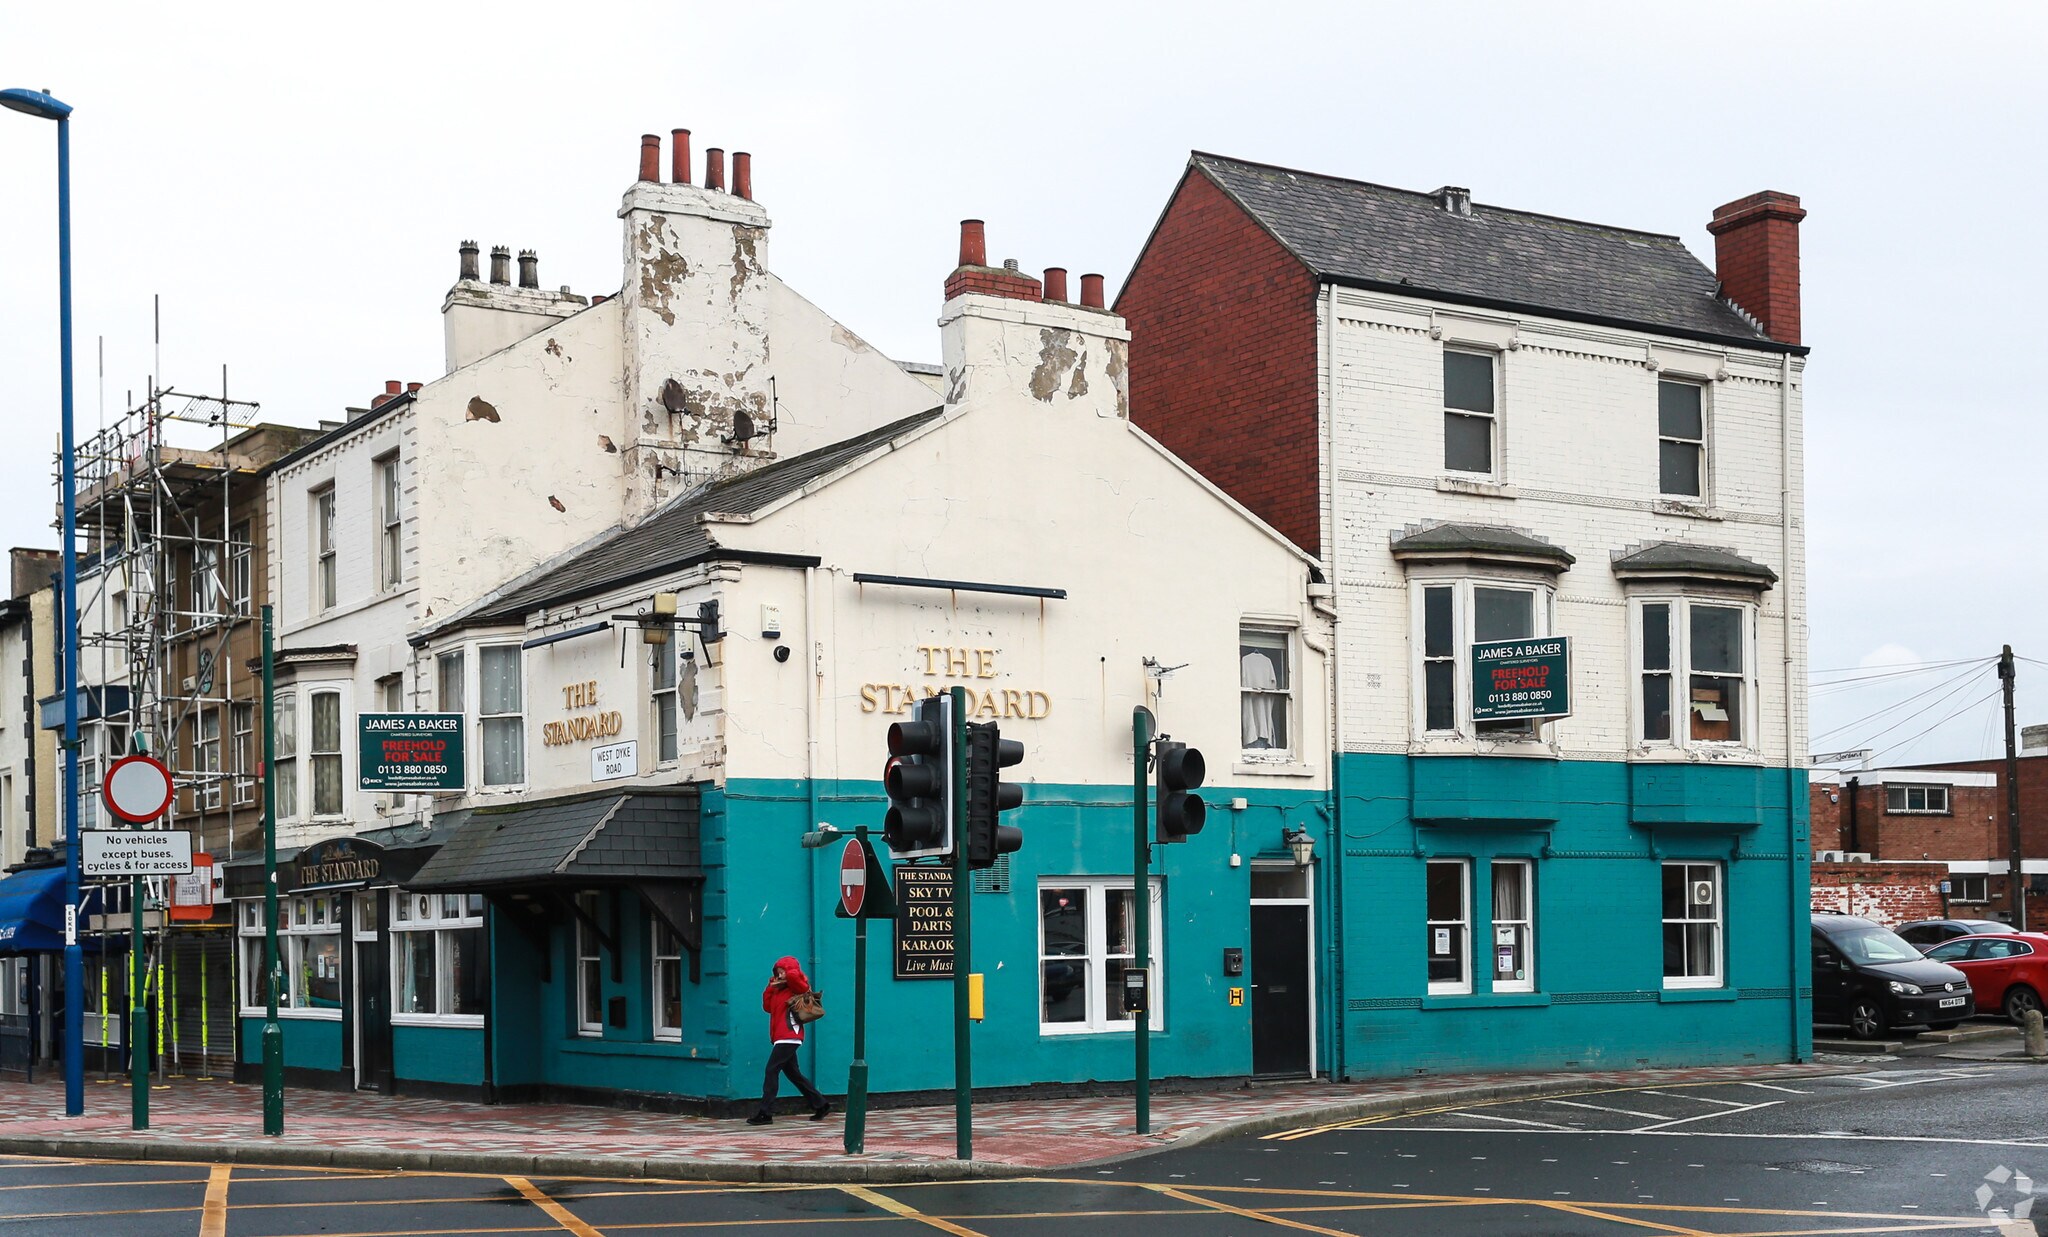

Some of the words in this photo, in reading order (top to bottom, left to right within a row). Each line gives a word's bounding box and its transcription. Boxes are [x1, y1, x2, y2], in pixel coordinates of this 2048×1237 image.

[1477, 647, 1513, 660] JAMES
[1515, 647, 1524, 657] A
[1526, 643, 1561, 656] BAKER
[917, 645, 996, 679] THE
[1491, 665, 1550, 680] FREEHOLD
[1495, 680, 1517, 691] FOR
[1520, 677, 1547, 689] SALE
[562, 680, 598, 710] THE
[1489, 693, 1510, 703] 0113
[1512, 692, 1529, 701] 880
[1530, 690, 1552, 700] 0850
[366, 720, 405, 730] JAMES
[407, 720, 417, 730] A
[419, 720, 458, 730] BAKER
[543, 711, 623, 747] STANDARD
[382, 740, 447, 751] FREEHOLD
[385, 752, 410, 763] FOR
[413, 752, 443, 763] SALE
[597, 750, 613, 763] WEST
[616, 747, 631, 759] DYKE
[378, 765, 402, 774] 0113
[404, 765, 422, 774] 880
[424, 765, 448, 774] 0850
[606, 763, 622, 775] ROAD
[106, 836, 122, 845] No
[125, 836, 168, 845] vehicles
[102, 850, 138, 860] except
[87, 862, 121, 872] cycles
[125, 861, 132, 870] &
[135, 861, 151, 870] for
[301, 865, 320, 884] THE
[322, 859, 379, 883] STANDARD
[899, 872, 917, 880] THE
[918, 872, 953, 881] STANDA
[909, 888, 934, 898] SKY
[936, 888, 953, 898] TV
[909, 907, 943, 918] POOL
[945, 907, 954, 917] &
[912, 921, 952, 932] DARTS
[902, 940, 955, 951] KARAOK
[906, 960, 926, 972] Live
[930, 959, 954, 971] Musi
